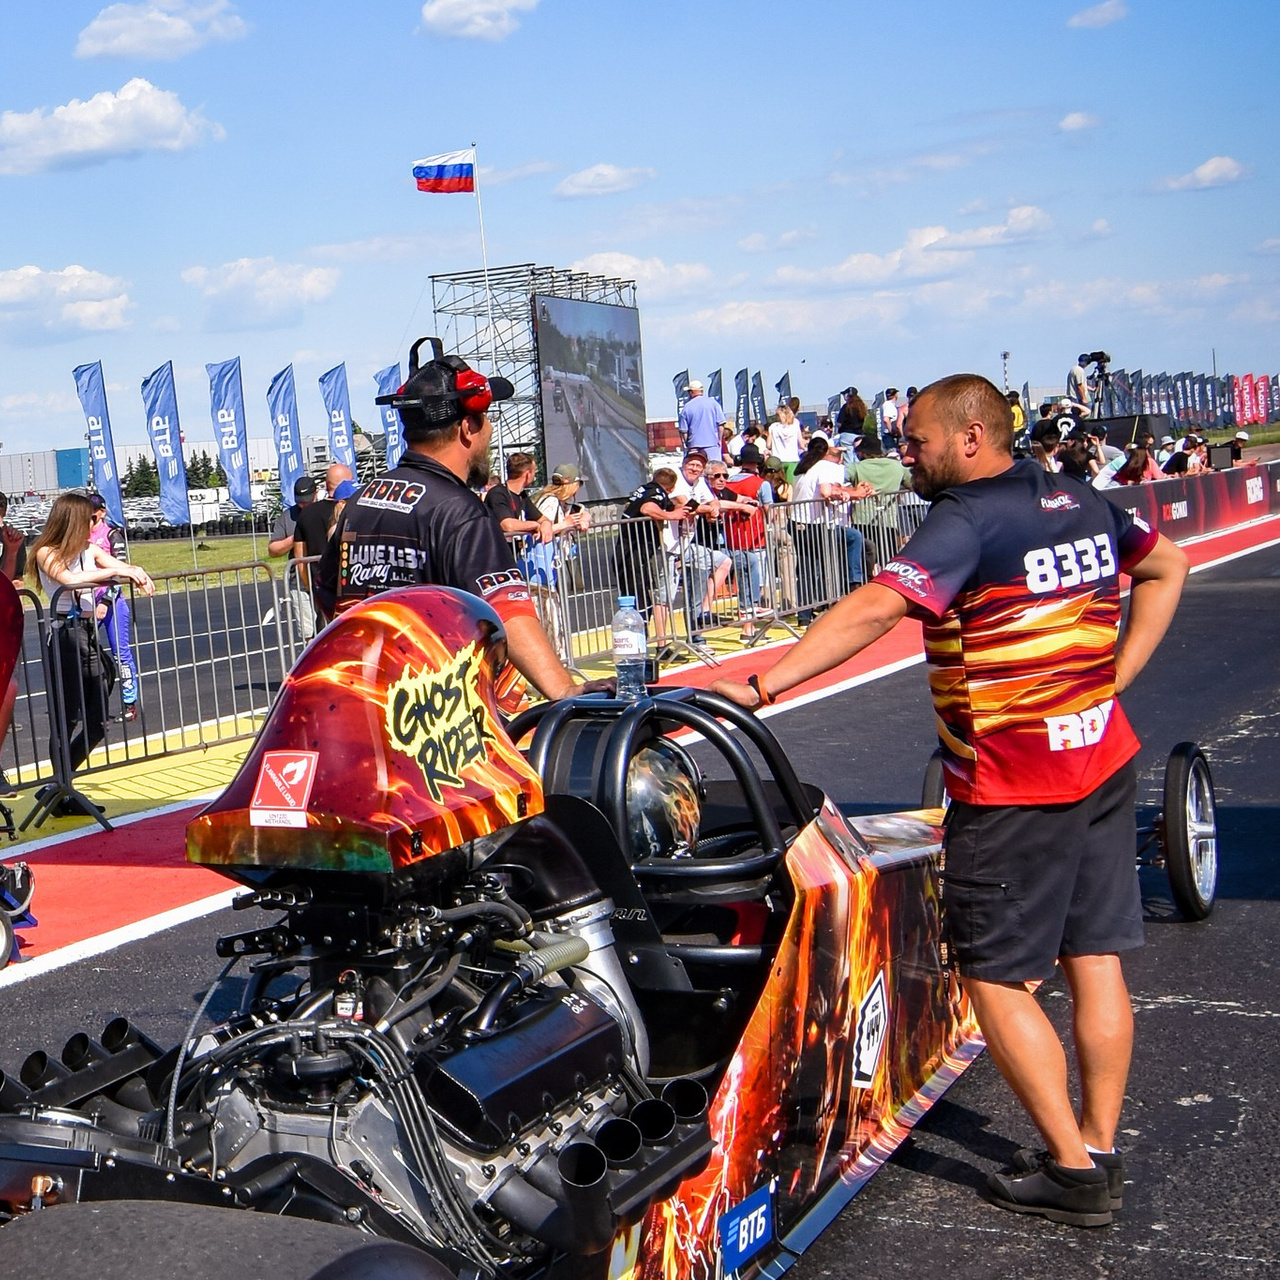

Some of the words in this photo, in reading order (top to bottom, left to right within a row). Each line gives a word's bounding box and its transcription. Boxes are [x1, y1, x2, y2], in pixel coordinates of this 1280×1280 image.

[477, 570, 525, 591] RDR
[1023, 533, 1116, 594] 8333
[393, 657, 472, 746] GHOST
[417, 705, 496, 802] RIDER
[264, 763, 285, 794] FLAMMABLE
[281, 790, 297, 807] LIQUID
[738, 1203, 767, 1254] ВТБ
